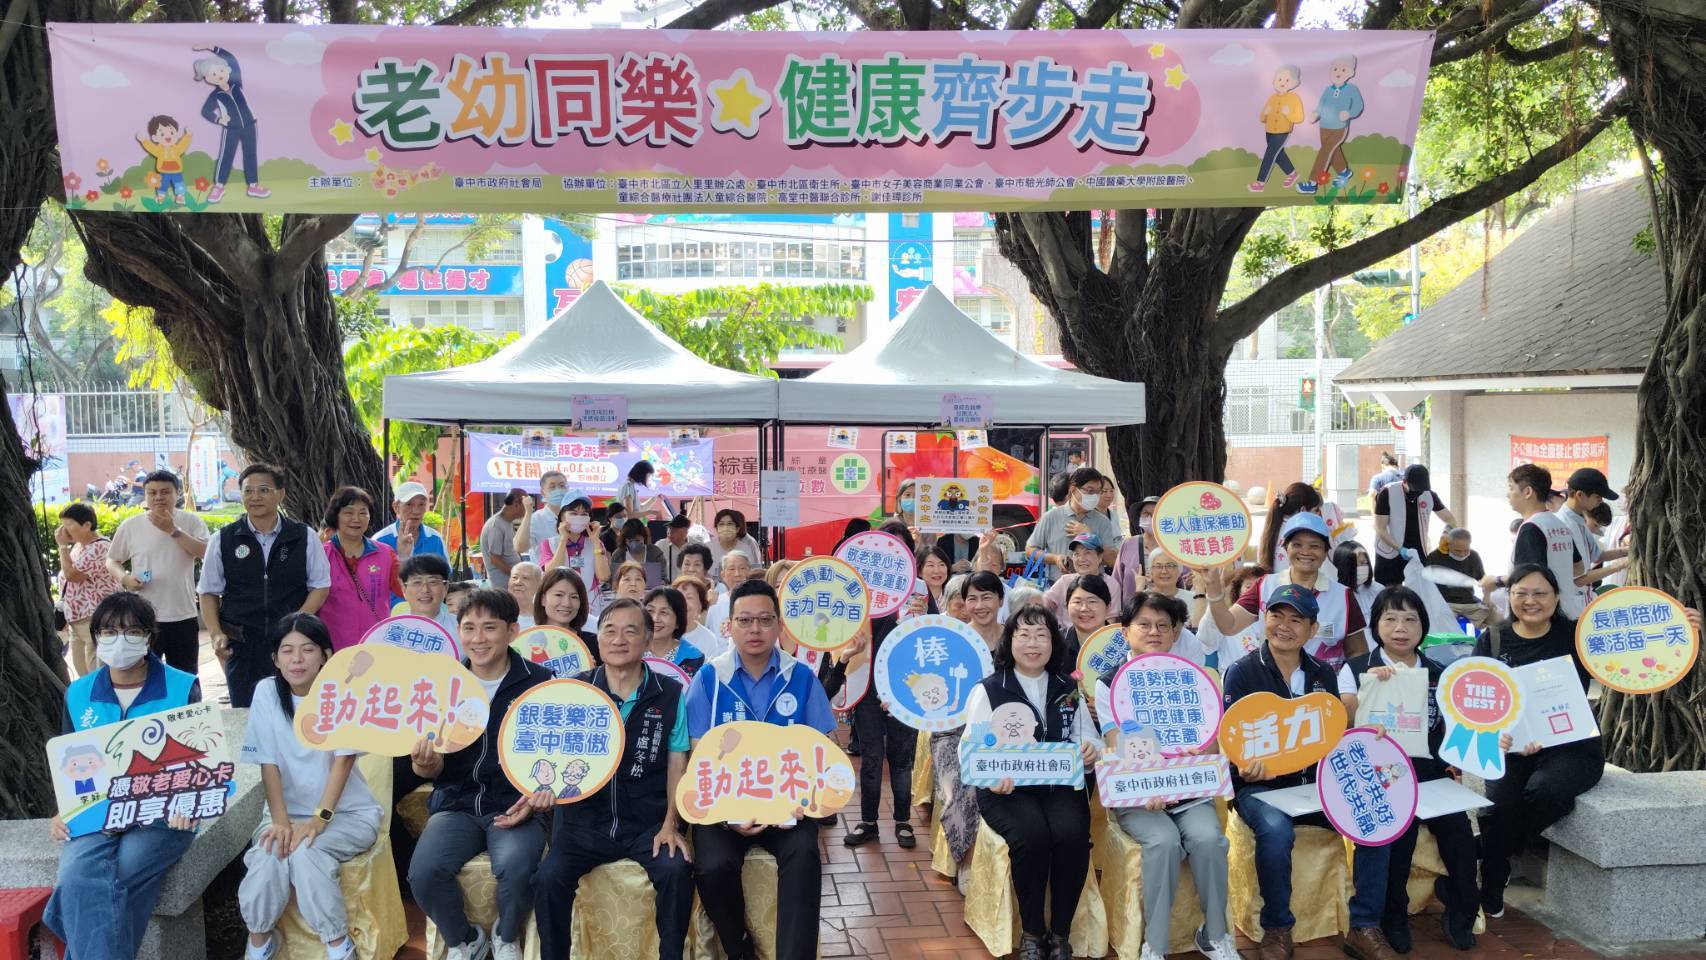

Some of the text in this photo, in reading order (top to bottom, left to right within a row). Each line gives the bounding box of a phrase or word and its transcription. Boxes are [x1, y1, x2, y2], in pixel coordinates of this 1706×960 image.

[359, 57, 1151, 148] 老幼同樂 健康齊步走
[454, 177, 543, 190] 臺中市政府社會局
[1160, 513, 1246, 533] 老人健保補助
[1179, 535, 1234, 556] 減輕負擔
[847, 548, 906, 571] 敬老愛心卡
[788, 565, 862, 597] 長青動一動
[856, 565, 907, 592] 就醫運動
[785, 591, 861, 620] 活力百分百
[1594, 604, 1671, 629] 長青陪你
[386, 626, 444, 650] 臺中市
[1587, 626, 1686, 653] 樂活每一天
[914, 636, 949, 667] 棒
[1128, 670, 1197, 687] 弱勢長輩
[1464, 683, 1496, 697] THE
[316, 676, 463, 734] 動起來!
[1131, 690, 1200, 706] 假牙補助
[1463, 698, 1496, 710] BEST
[167, 705, 212, 722] 敬老愛心卡
[517, 704, 611, 728] 銀髮樂活
[1135, 708, 1205, 725] 口腔健康
[514, 730, 609, 753] 臺中驕傲
[1241, 705, 1322, 760] 活力
[696, 745, 828, 808] 動起來!
[975, 757, 1072, 773] 臺中市政府社會局
[109, 763, 233, 798] 憑敬老愛心卡
[1114, 769, 1217, 793] 臺中市政府社會局
[1349, 741, 1394, 826] 老少共好
[1330, 750, 1377, 836] 世代共融
[105, 787, 229, 831] 即享優惠
